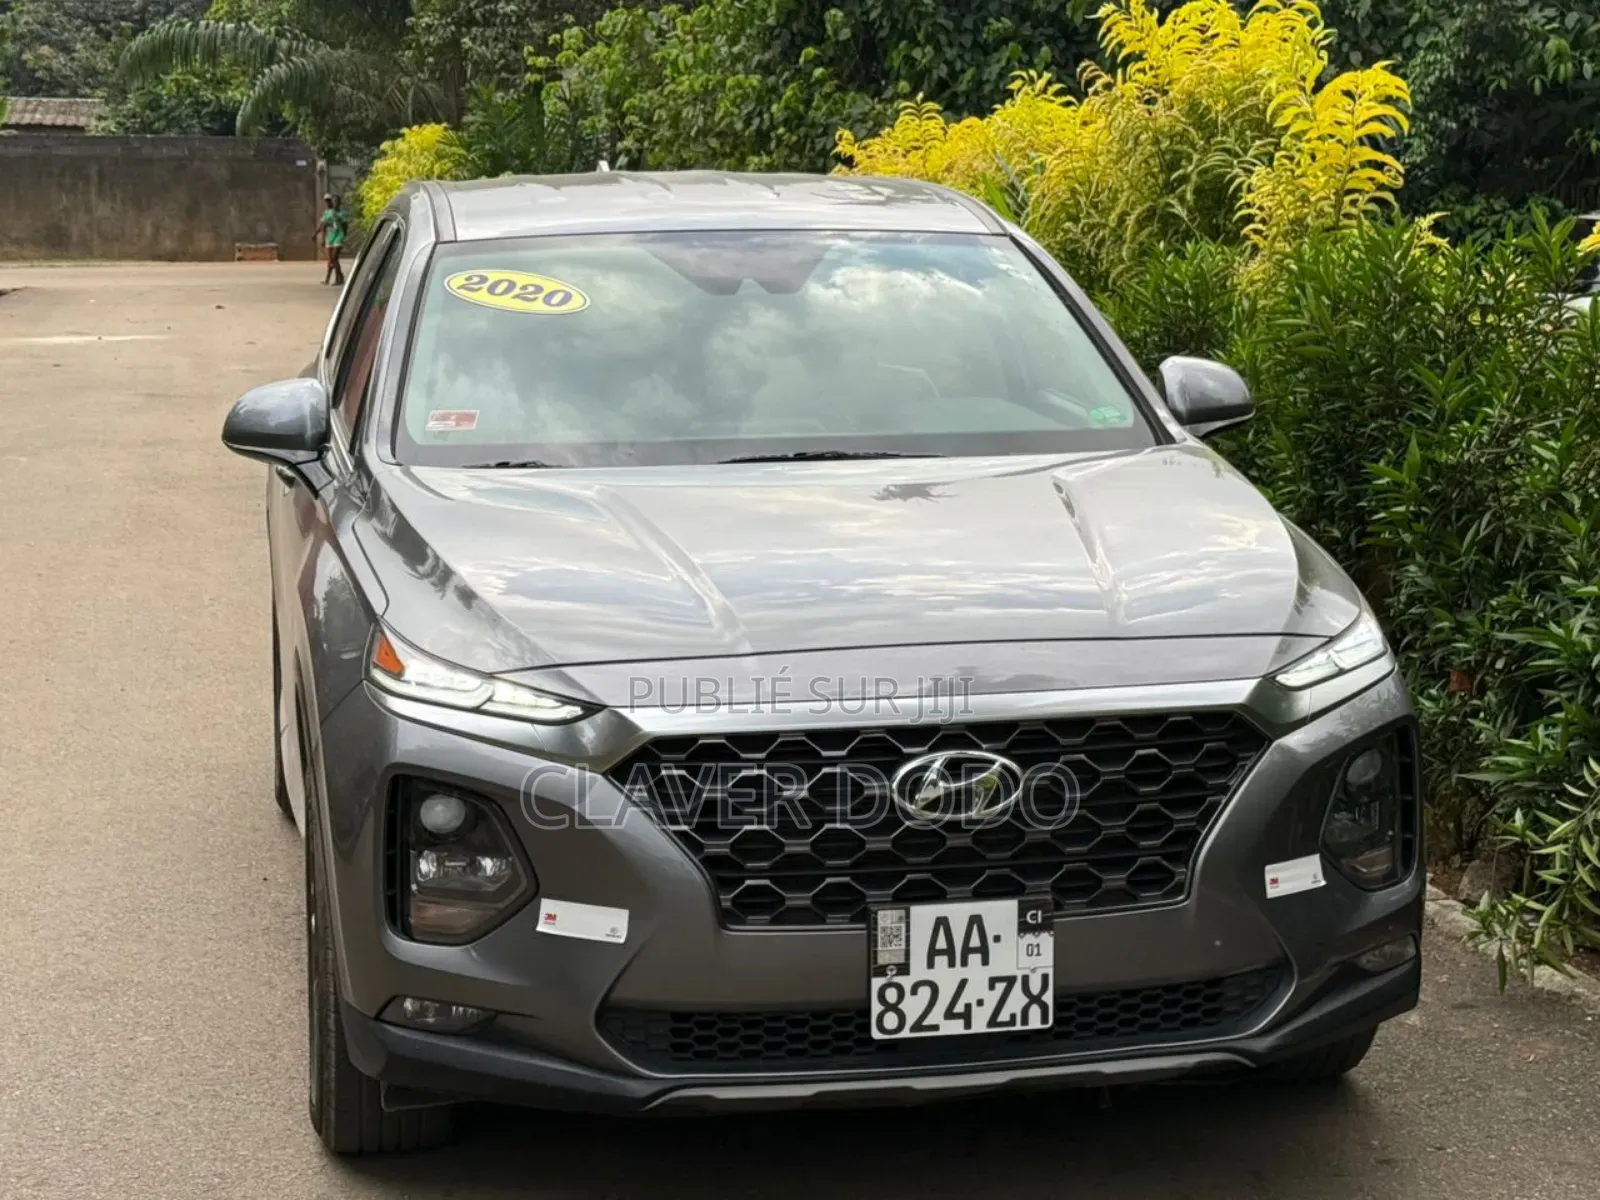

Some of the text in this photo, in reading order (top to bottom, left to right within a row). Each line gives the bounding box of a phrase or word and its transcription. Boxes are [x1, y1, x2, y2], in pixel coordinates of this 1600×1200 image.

[457, 274, 573, 307] 2020
[1026, 910, 1042, 924] CI
[1026, 943, 1042, 957] 01
